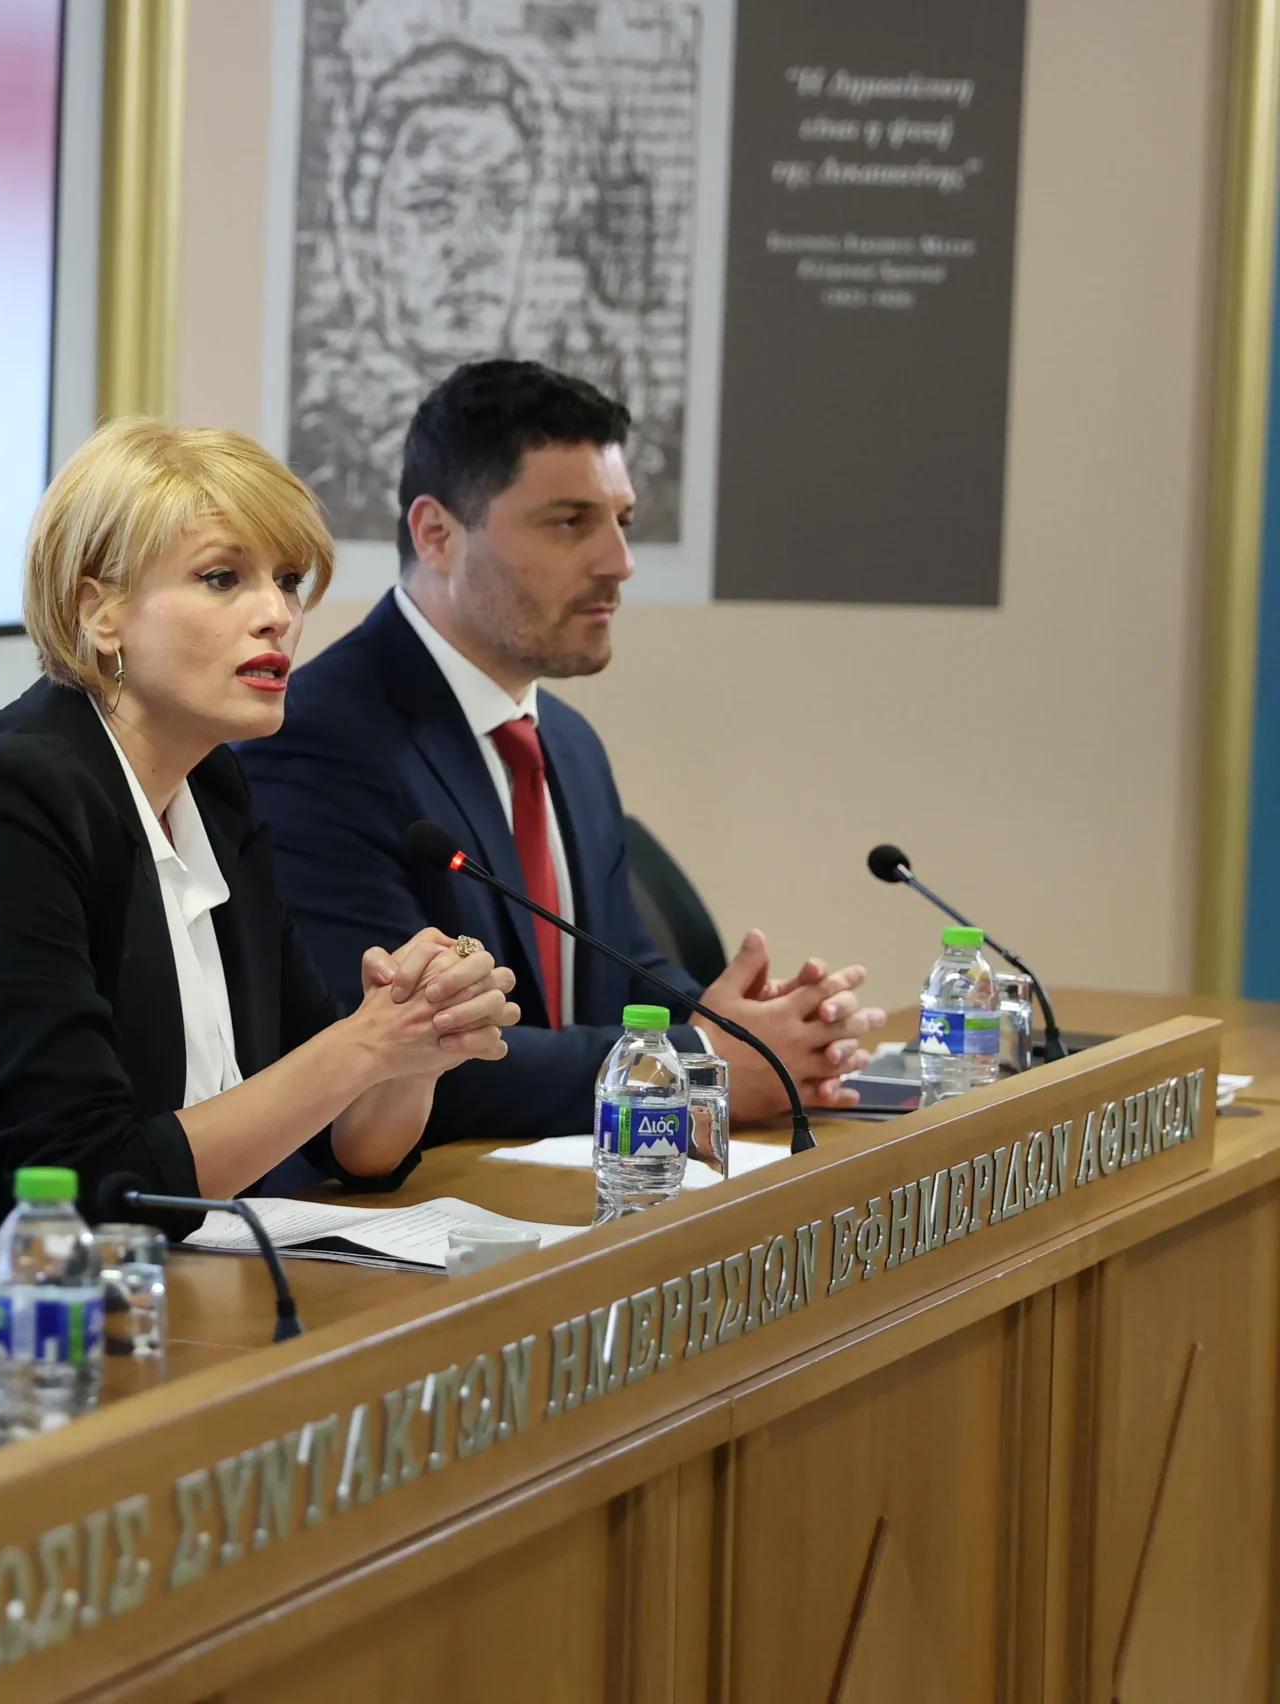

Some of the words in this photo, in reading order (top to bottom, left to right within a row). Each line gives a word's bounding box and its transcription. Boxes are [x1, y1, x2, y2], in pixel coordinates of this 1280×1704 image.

[637, 1115, 675, 1136] Διός
[170, 1334, 536, 1588] ΣΥΝΤΑΚΤΩΝ
[546, 1219, 823, 1420] ΗΜΕΡΗΣΙΩΝ
[828, 1119, 1074, 1297] ΕΦΗΜΕΡΙΔΩΝ
[1076, 1067, 1206, 1187] ΑΘΗΝΩΝ
